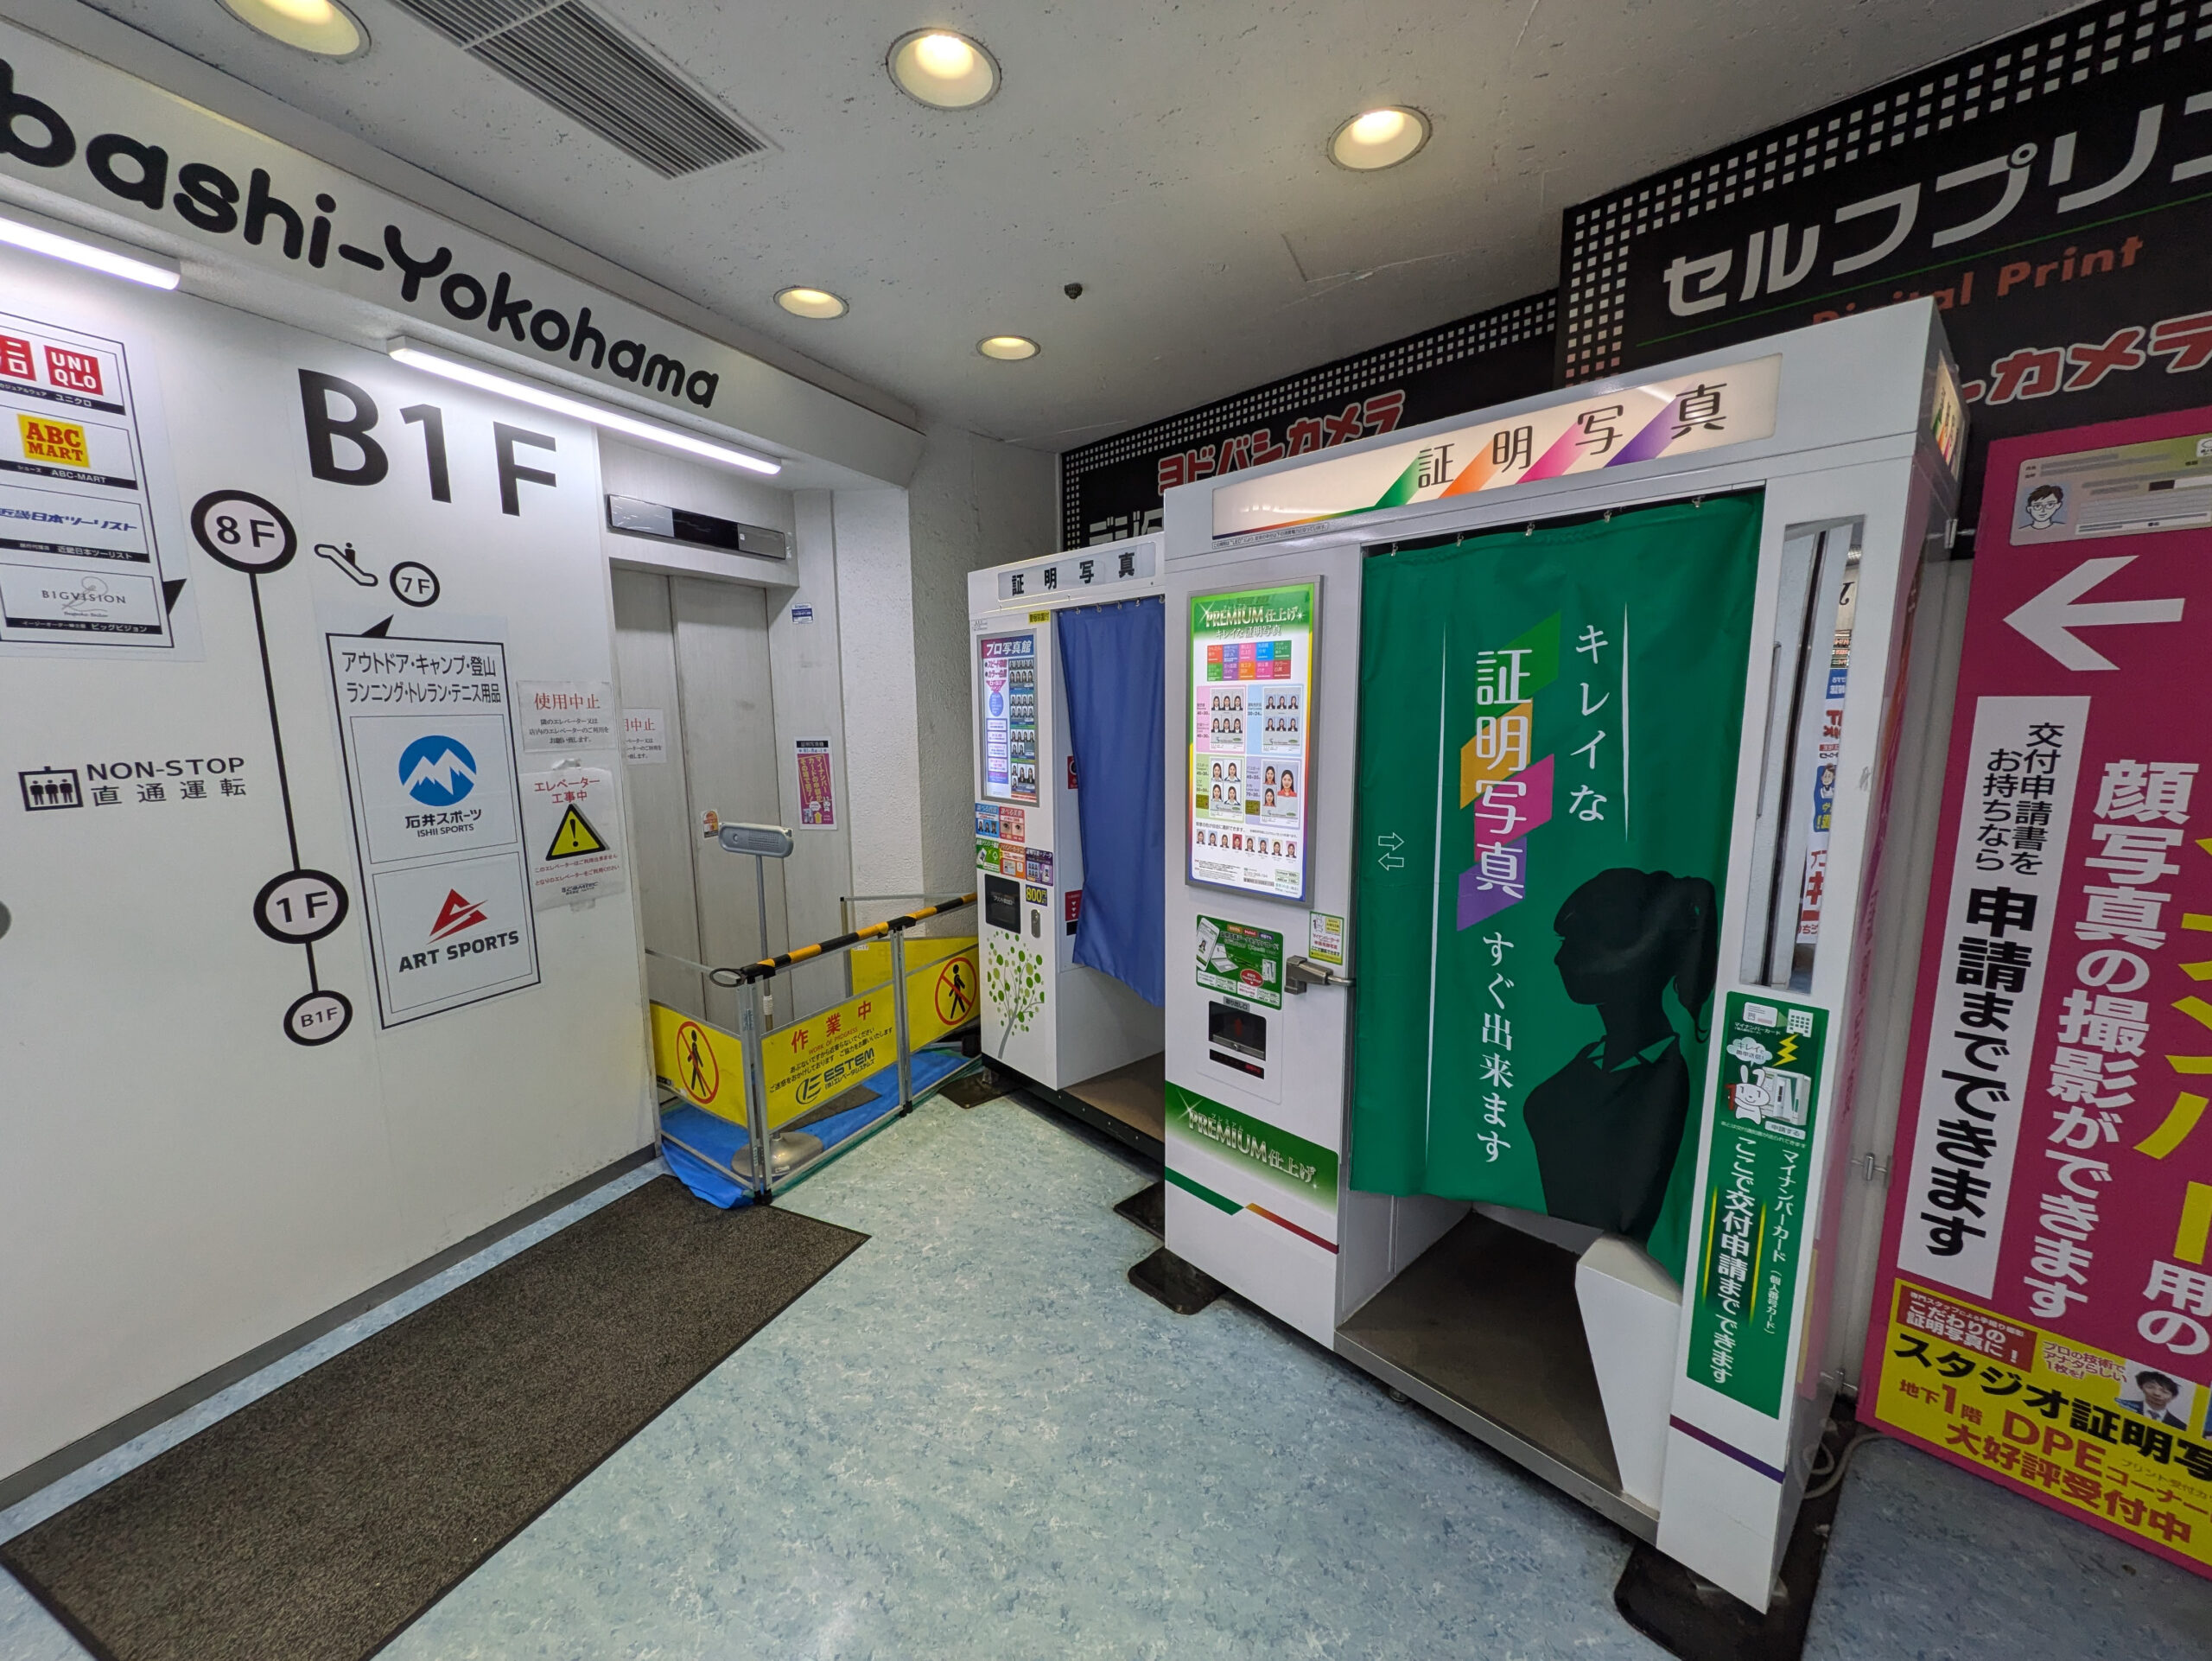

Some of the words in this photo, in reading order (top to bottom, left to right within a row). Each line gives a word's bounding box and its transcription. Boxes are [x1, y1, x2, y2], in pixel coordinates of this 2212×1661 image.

[1998, 235, 2144, 297] Print
[51, 352, 92, 372] UNI
[1961, 310, 2212, 405] カメラ
[54, 368, 98, 389] QLO
[55, 393, 92, 407] ユニクロ
[27, 421, 82, 448] ABC
[27, 441, 84, 461] MART
[298, 367, 557, 517] B1F
[1158, 389, 1406, 496] ヨドバシカメラ
[1419, 383, 1728, 488] 証明写真
[52, 468, 107, 484] ABC-MART
[216, 515, 275, 548] 8F
[57, 545, 133, 560] 近畿日本ツーリスト
[401, 576, 430, 595] 7F
[1012, 551, 1135, 596] 証明写真
[41, 589, 127, 604] BIGVISION
[91, 622, 148, 633] ビッグビジョン
[1205, 606, 1264, 627] PREMIUM
[1265, 605, 1299, 622] 仕上げ
[1216, 624, 1282, 640] キレイな証明写真
[341, 651, 497, 678] アウトドア・キャンプ・登山
[986, 640, 1032, 657] プロ写真館
[346, 681, 502, 703] ランニング・トレラン・テニス用品
[534, 692, 601, 710] 使用中止
[1568, 624, 1610, 822] キレイな
[86, 757, 245, 781] NON-STOP
[534, 777, 601, 792] エレベーター
[1474, 648, 1534, 901] 証明写真
[91, 778, 246, 806] 直通運転
[551, 790, 588, 804] 工事中
[2009, 722, 2066, 876] 交付申請書を
[404, 808, 482, 830] 石井スポーツ
[1975, 748, 2024, 871] お持ちなら
[416, 827, 439, 837] ISHII
[440, 823, 474, 836] SPORTS
[276, 890, 329, 923] 1F
[398, 948, 440, 973] ART
[446, 930, 519, 961] SPORTS
[301, 1006, 339, 1028] B1F
[791, 1000, 872, 1053] 作業中
[1477, 931, 1516, 1164] すぐ出来ます
[2023, 759, 2200, 1319] 顔写真の撮影ができます
[823, 1047, 875, 1083] ESTEM
[1920, 886, 2038, 1257] 申請までできます
[1189, 1110, 1267, 1163] PREMIUM
[1268, 1149, 1317, 1183] 仕上げ
[1709, 1136, 1757, 1384] ここで交付申請までできます
[1909, 1300, 2006, 1344] こだわりの
[2043, 1340, 2126, 1373] プロの技術で
[1898, 1378, 1984, 1426] 地下1階
[2002, 1410, 2212, 1523] DPEコーナー
[1945, 1423, 2192, 1544] 大好評受付中
[2121, 1458, 2212, 1499] プリント受付カ
